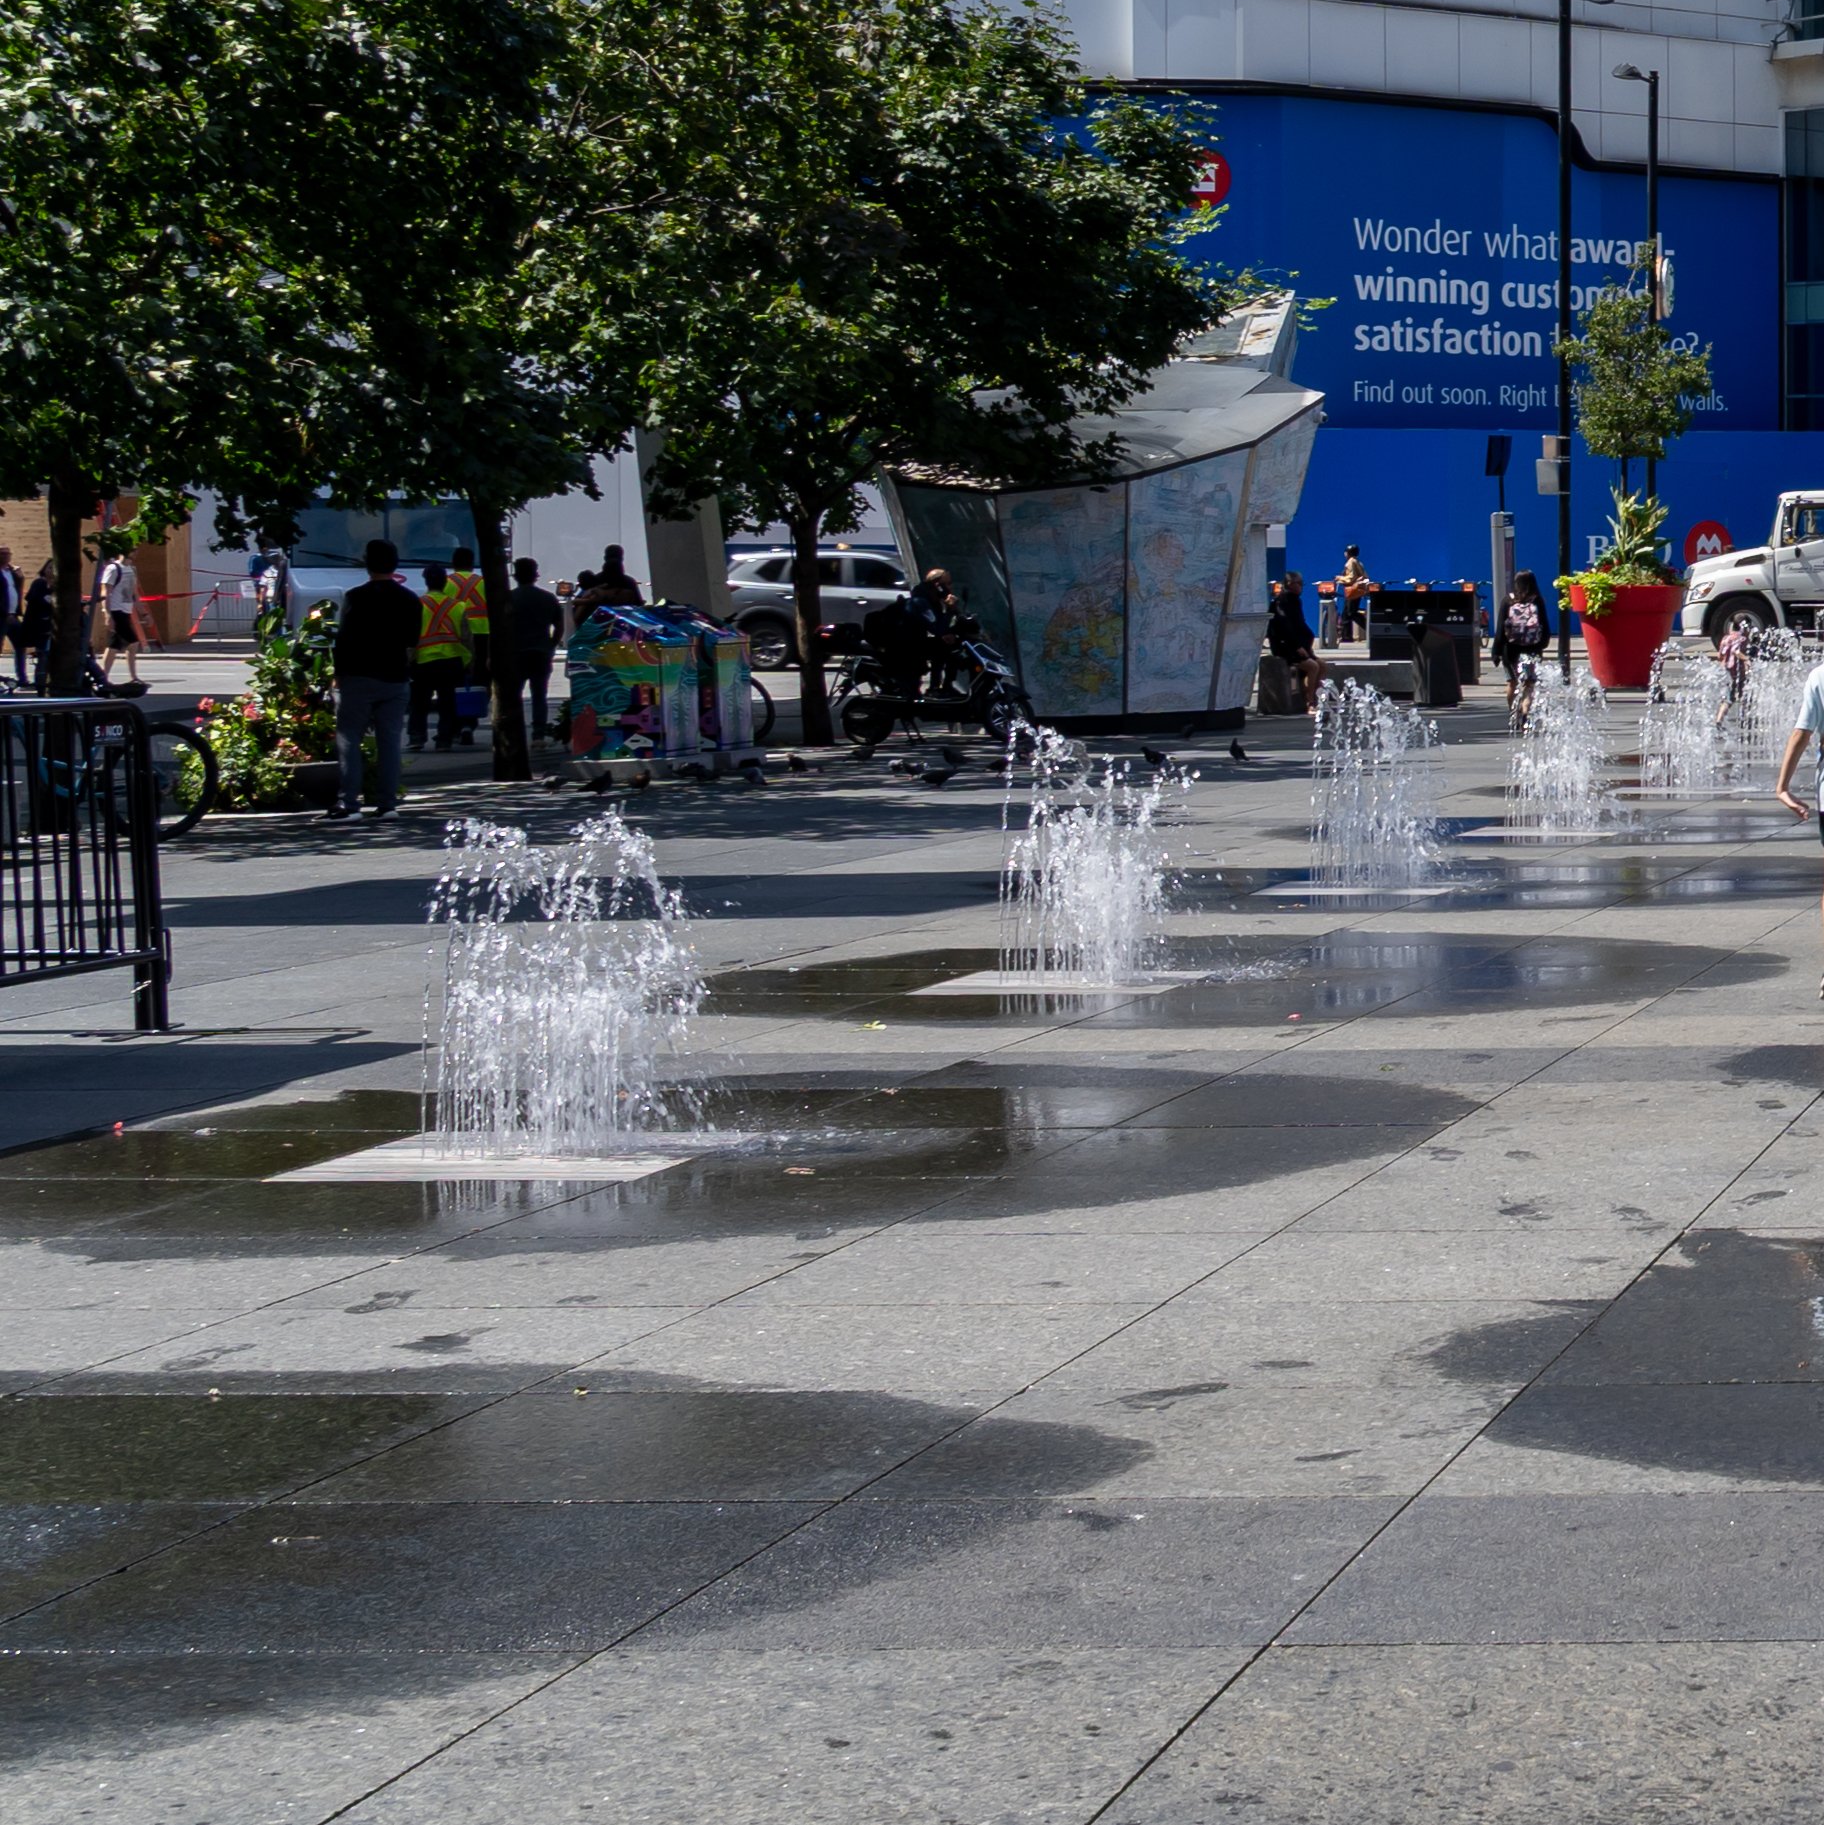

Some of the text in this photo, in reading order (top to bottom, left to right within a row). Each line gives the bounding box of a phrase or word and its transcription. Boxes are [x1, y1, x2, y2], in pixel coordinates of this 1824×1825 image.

[1353, 217, 1472, 256] Wonder
[1484, 223, 1560, 262] what
[1353, 266, 1489, 316] winning
[1354, 317, 1542, 357] satisfaction
[1353, 380, 1394, 403] Find
[1401, 384, 1434, 404] out
[1440, 388, 1492, 406] soon.
[1500, 383, 1547, 412] Right
